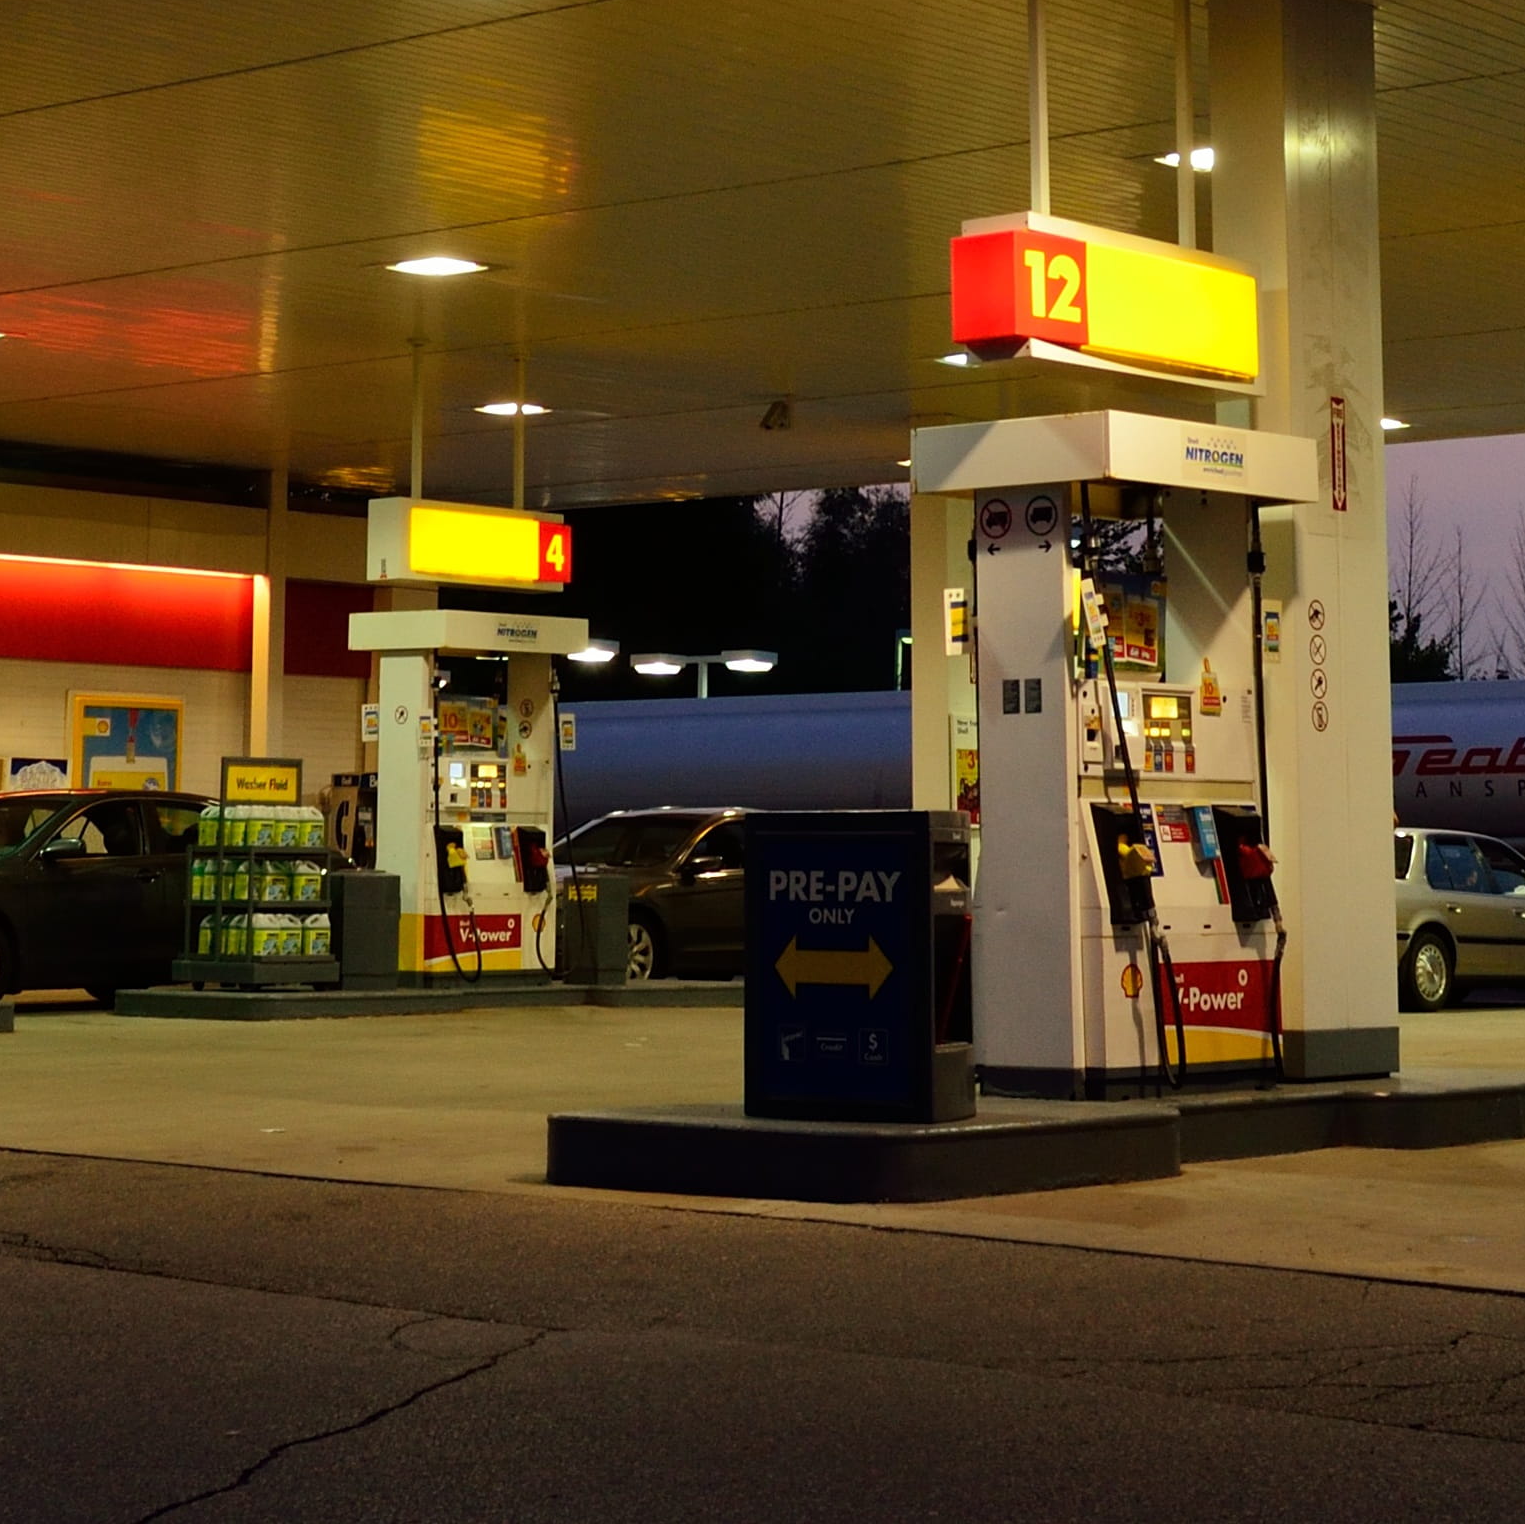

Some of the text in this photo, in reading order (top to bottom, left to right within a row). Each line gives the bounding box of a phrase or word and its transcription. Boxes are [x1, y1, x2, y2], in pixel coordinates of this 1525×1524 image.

[1024, 249, 1082, 323] 12
[1185, 445, 1244, 466] NITROGEN
[545, 533, 565, 572] 4
[236, 777, 288, 791] Washer Fluid
[769, 870, 902, 903] PRE-PAY
[809, 907, 855, 925] ONLY
